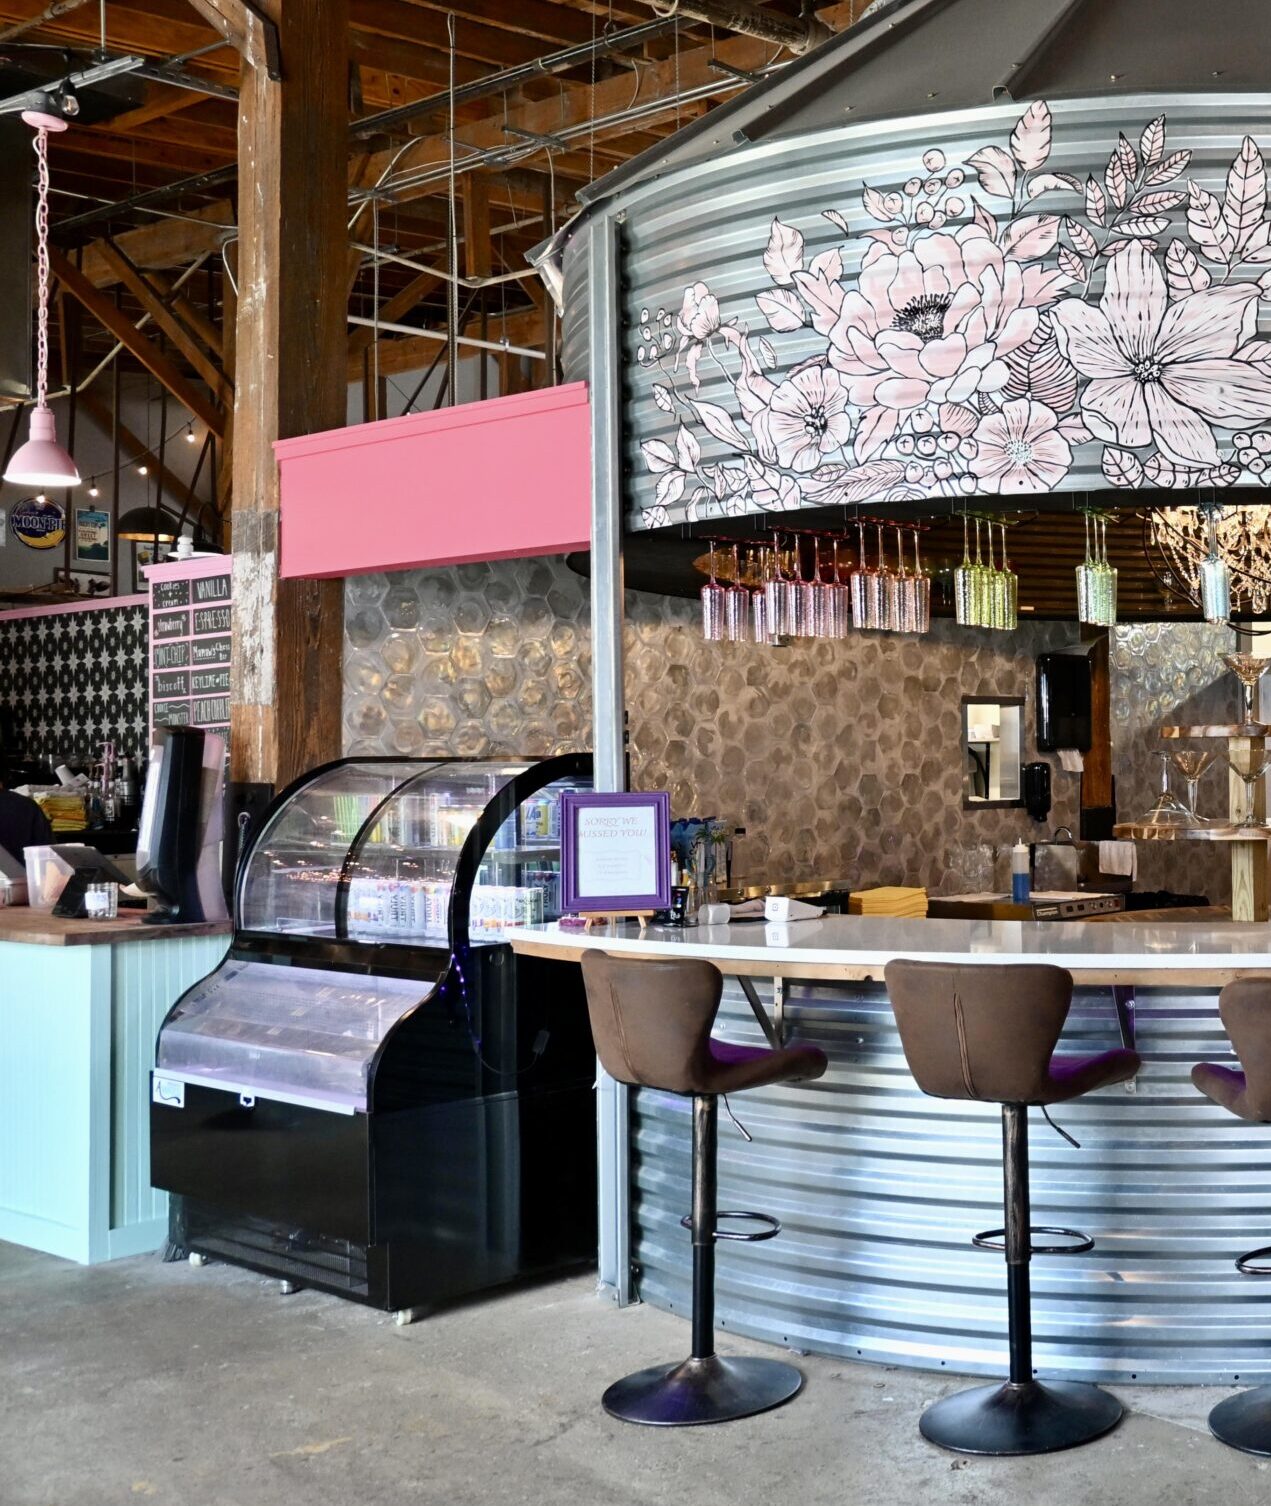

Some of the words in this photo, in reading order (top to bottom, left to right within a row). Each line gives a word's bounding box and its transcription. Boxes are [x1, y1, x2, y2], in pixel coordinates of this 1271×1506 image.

[197, 579, 228, 599] VANILLA
[585, 816, 620, 827] SORRY
[622, 816, 639, 826] WE
